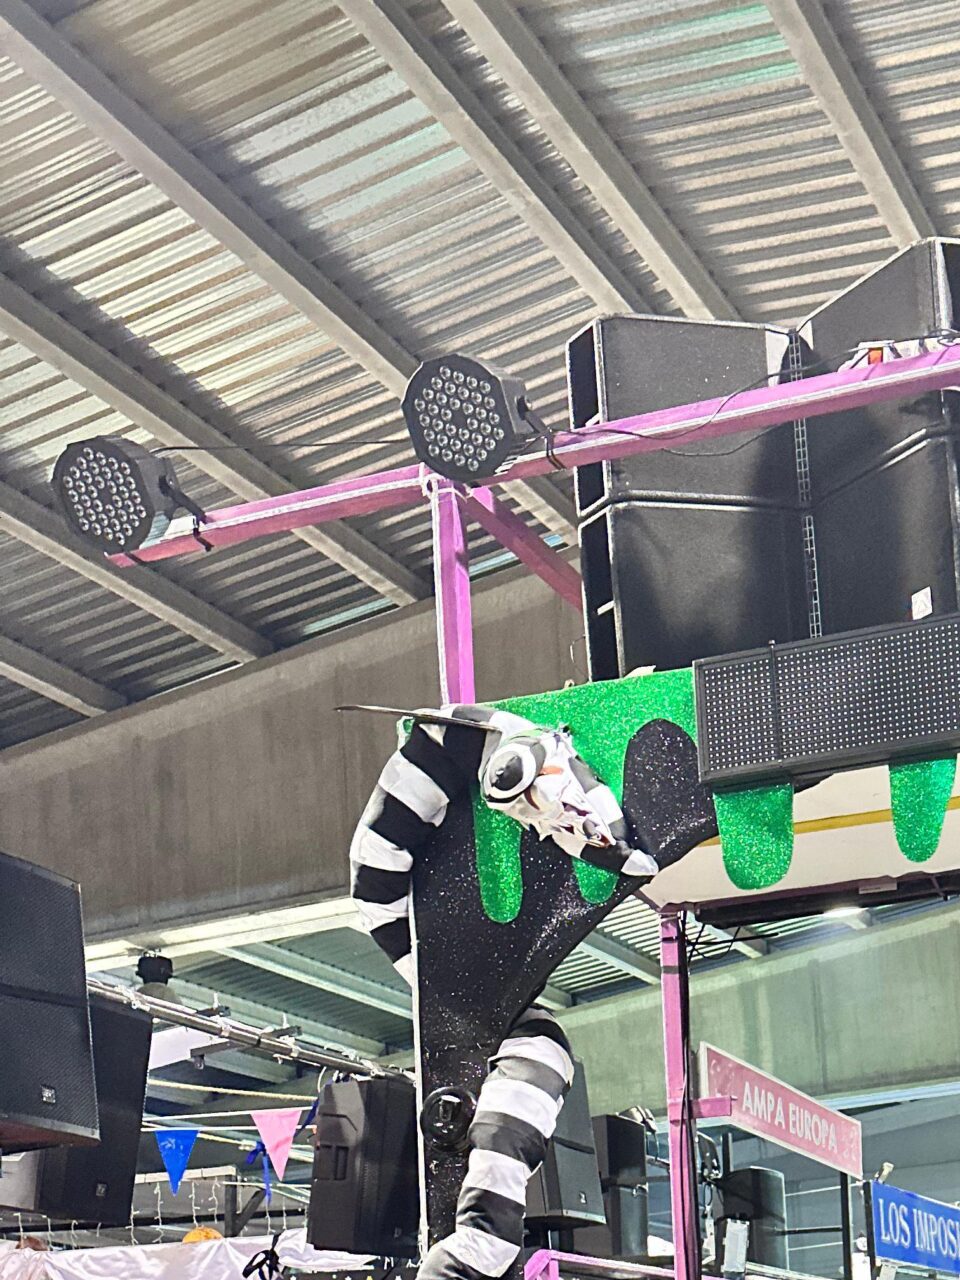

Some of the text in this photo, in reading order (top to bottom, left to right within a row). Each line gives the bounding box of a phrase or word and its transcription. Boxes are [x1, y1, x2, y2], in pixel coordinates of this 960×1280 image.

[742, 1081, 837, 1152] AMPA EUROPA
[878, 1198, 911, 1249] LOS
